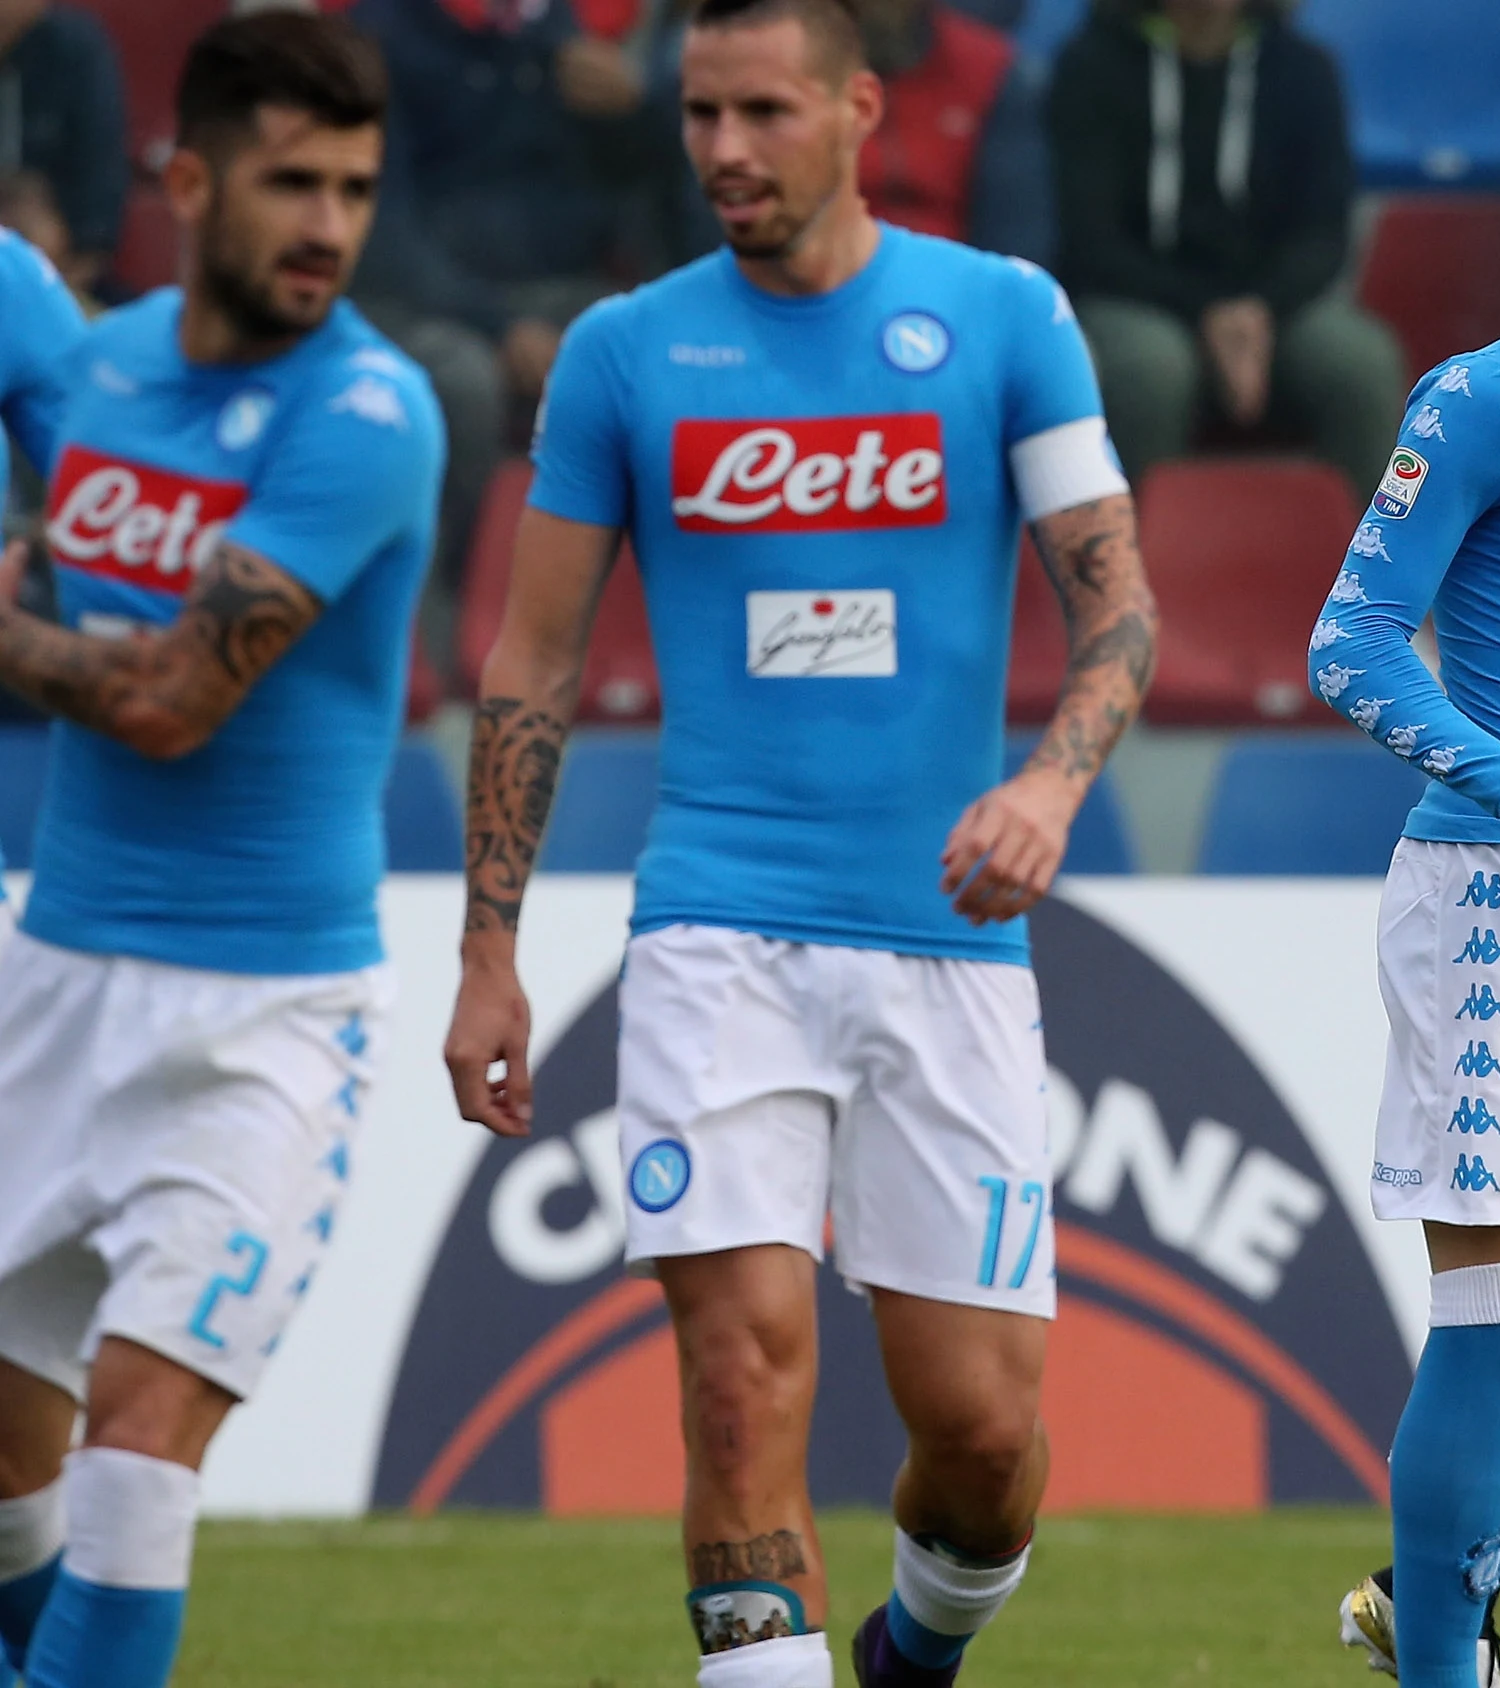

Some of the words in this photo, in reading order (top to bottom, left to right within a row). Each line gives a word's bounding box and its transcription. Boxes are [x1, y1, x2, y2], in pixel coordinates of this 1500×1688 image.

[671, 427, 943, 525] Lete
[1383, 498, 1402, 515] TIM
[1372, 1161, 1422, 1187] Kappa
[977, 1174, 1044, 1290] 17
[188, 1228, 269, 1351] 2
